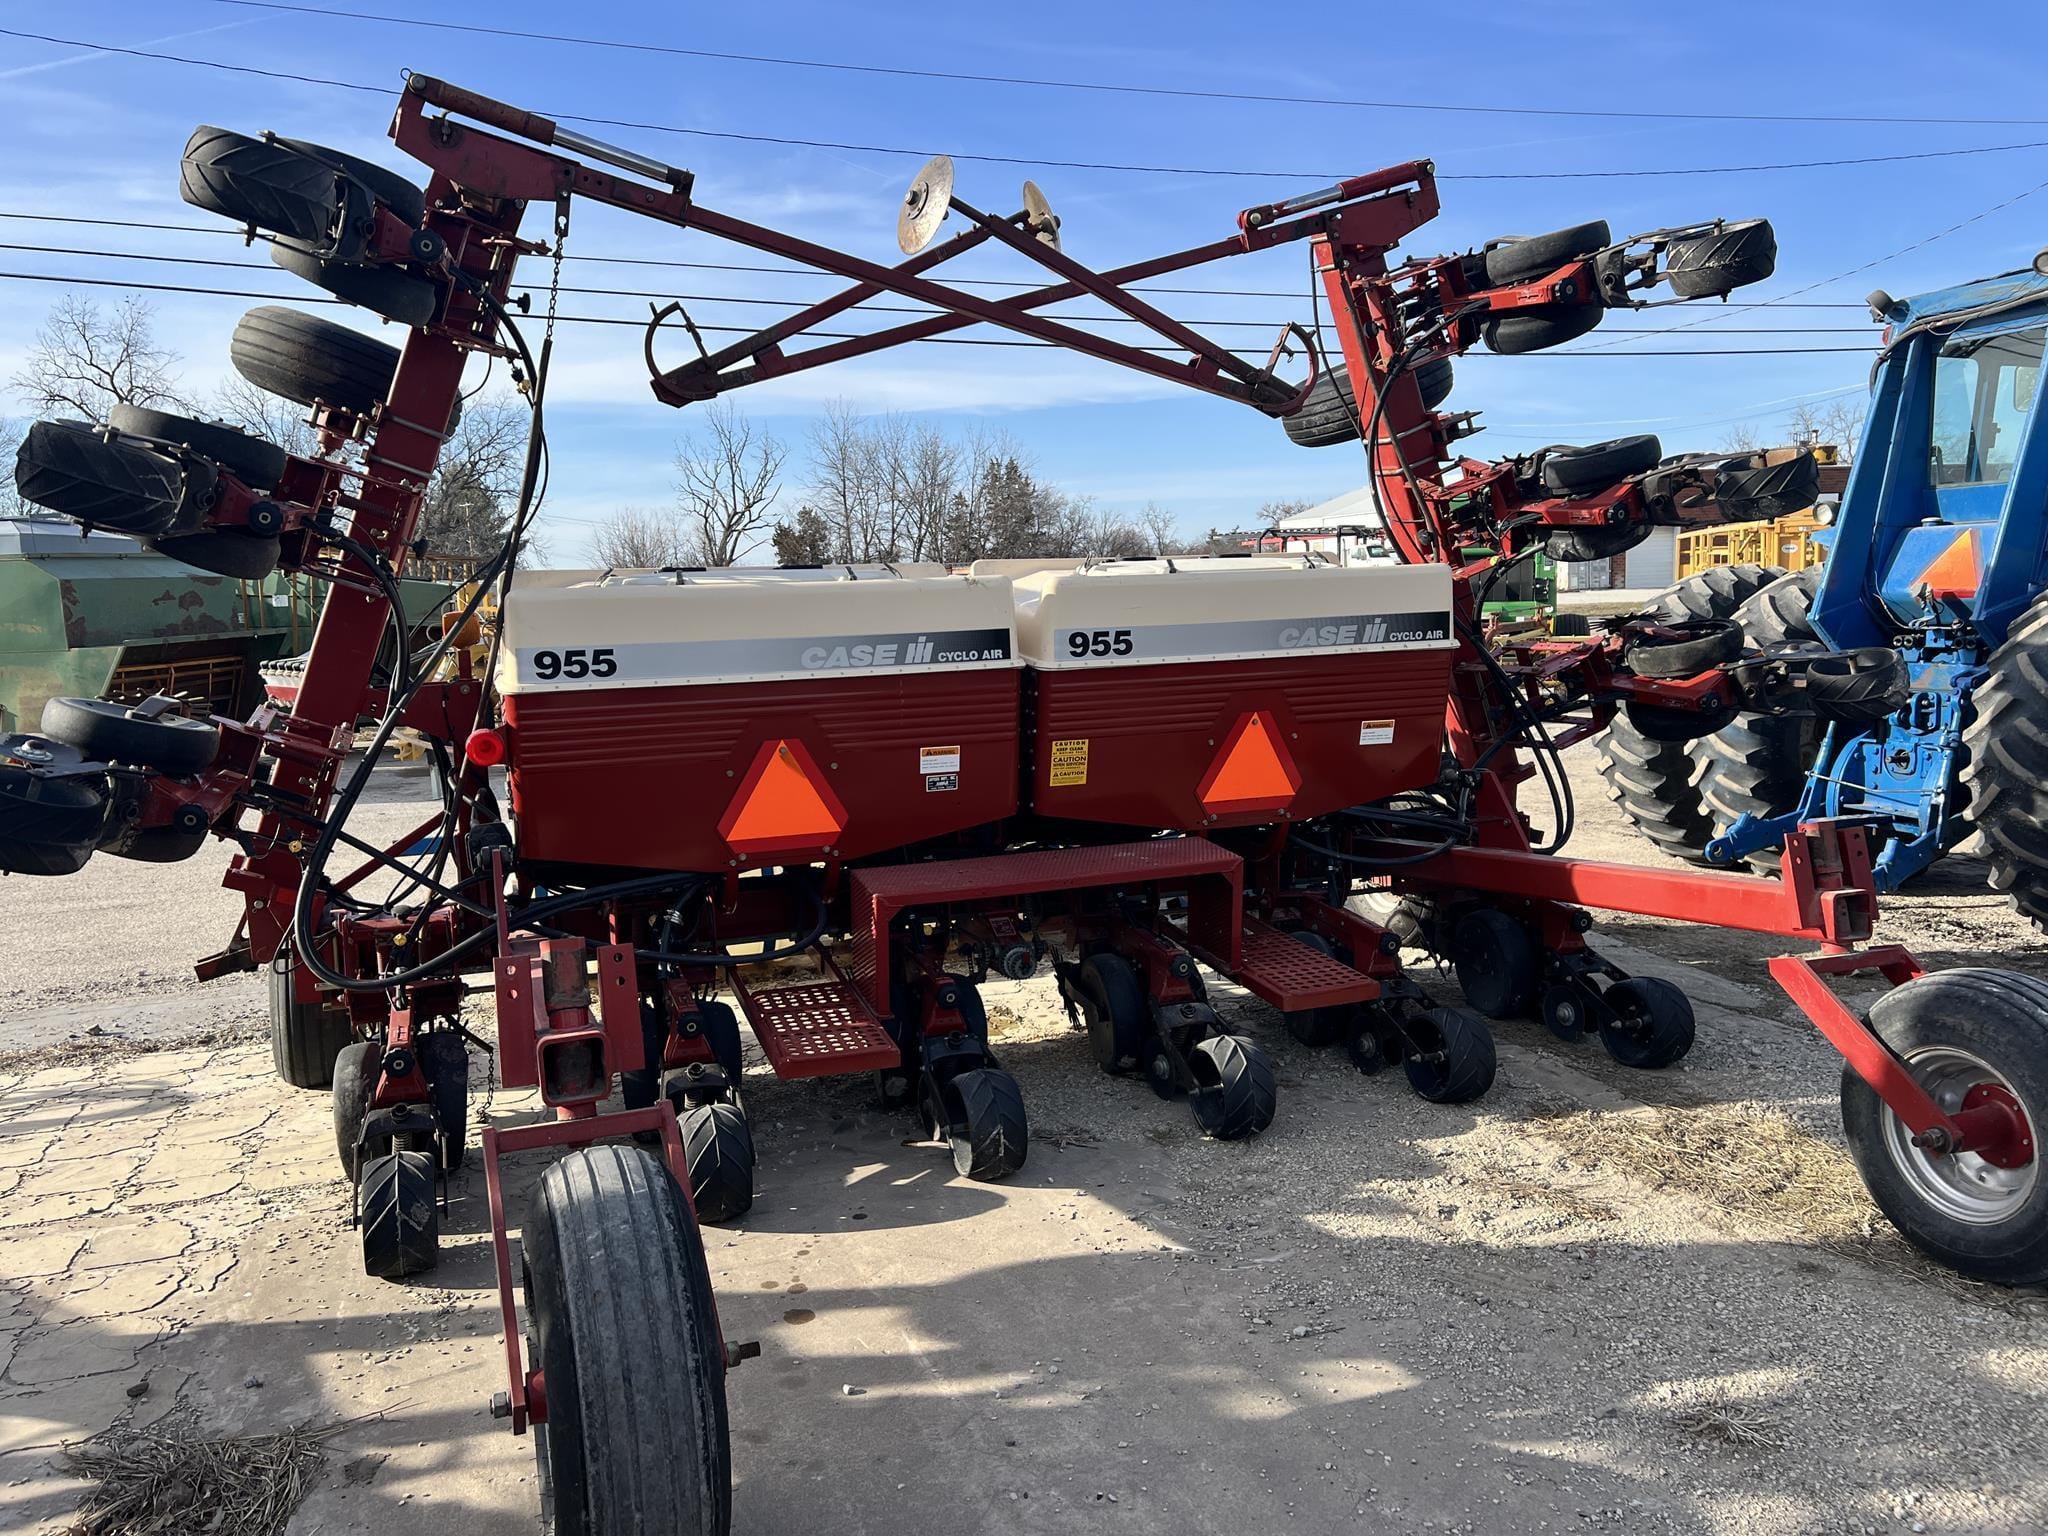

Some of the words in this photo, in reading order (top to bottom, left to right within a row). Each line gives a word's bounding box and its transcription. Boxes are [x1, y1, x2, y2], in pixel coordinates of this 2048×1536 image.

[1068, 630, 1133, 658] 955
[1279, 624, 1358, 648] CASE
[1390, 631, 1423, 642] CYCLO
[1425, 630, 1444, 640] AIR
[533, 648, 618, 680] 955
[801, 643, 898, 669] CASE
[938, 650, 978, 662] CYCLO
[982, 649, 1003, 660] AIR
